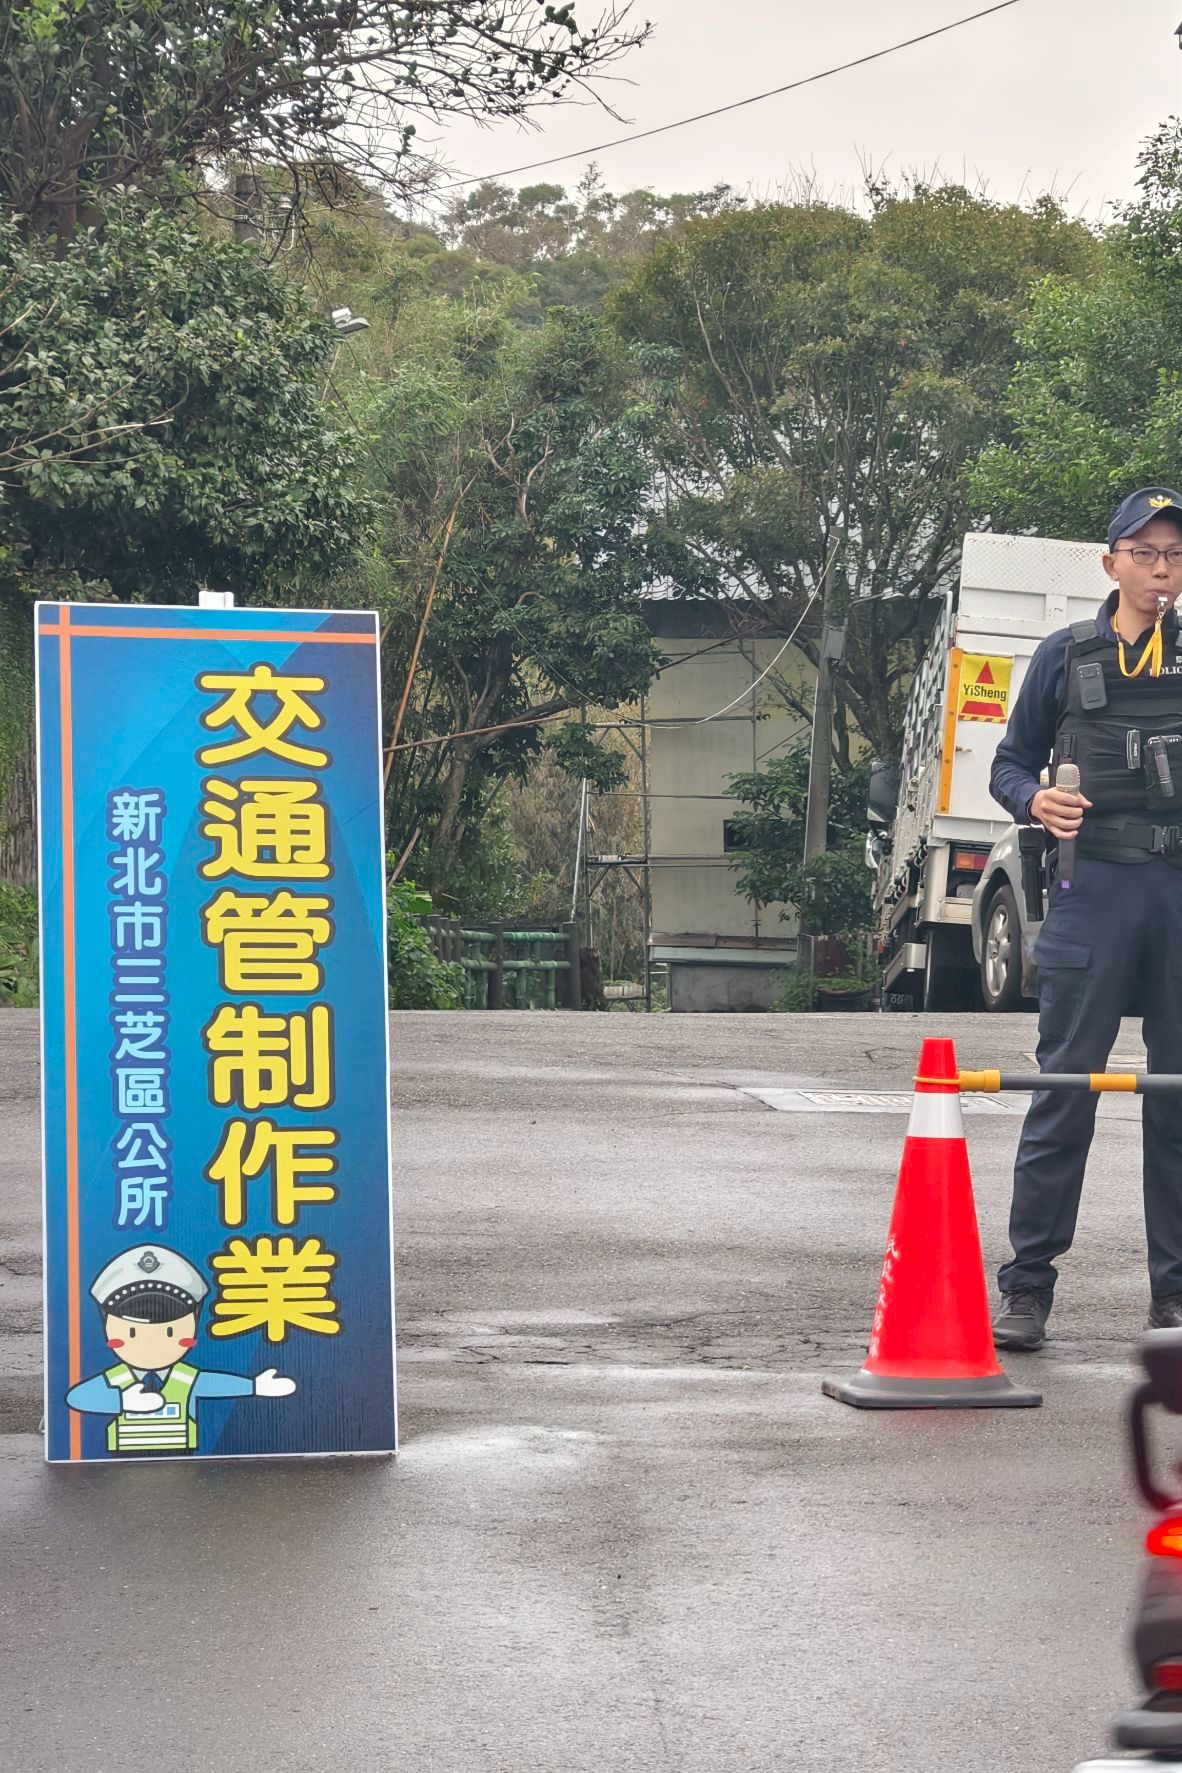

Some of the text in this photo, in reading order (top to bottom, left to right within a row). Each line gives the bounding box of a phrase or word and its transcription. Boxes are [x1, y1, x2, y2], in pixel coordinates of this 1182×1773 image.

[963, 684, 1007, 702] YiSheng
[112, 791, 168, 1228] 新北市三芝區公所
[202, 666, 340, 1341] 交通管制作業
